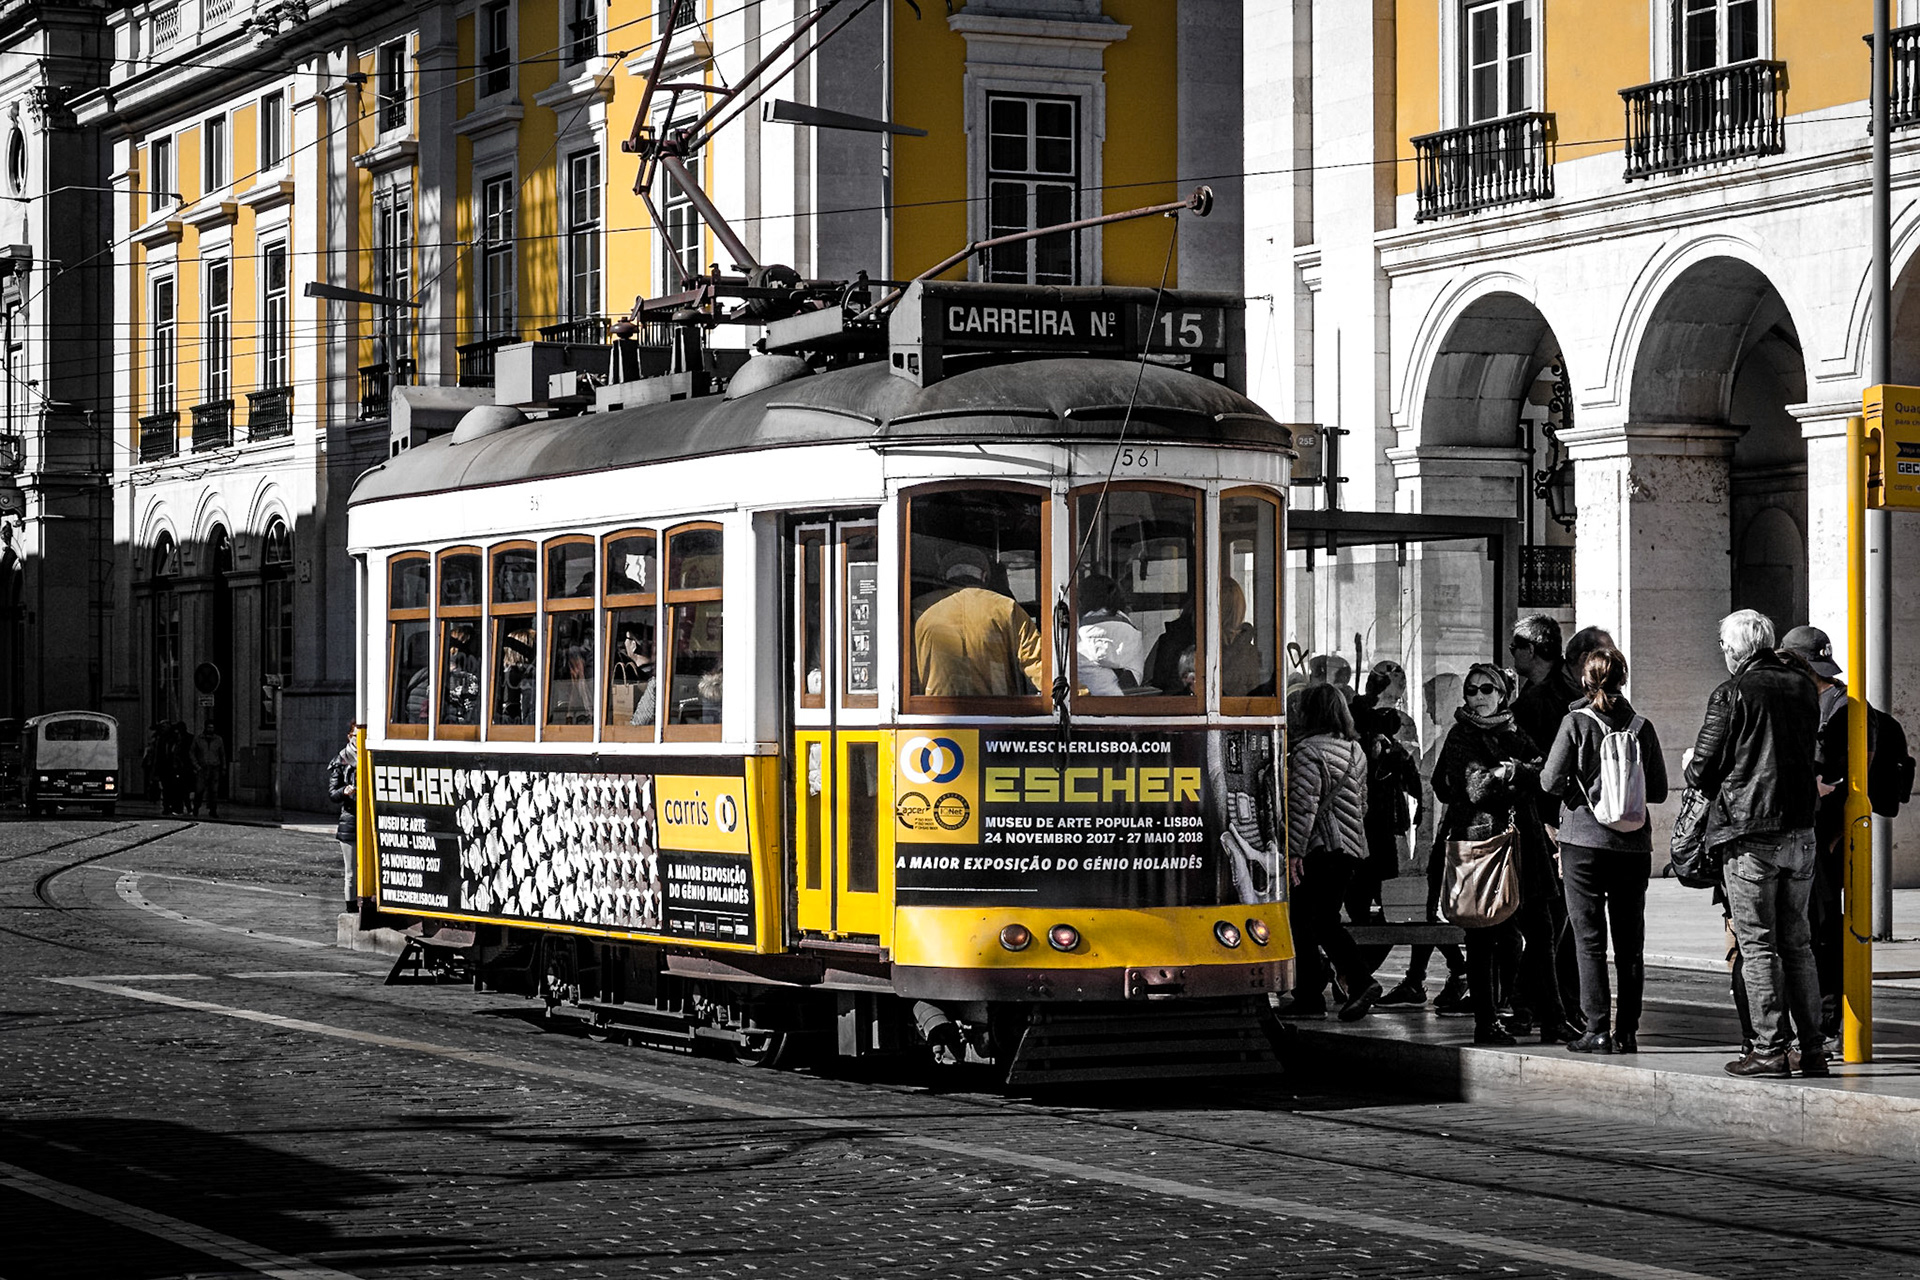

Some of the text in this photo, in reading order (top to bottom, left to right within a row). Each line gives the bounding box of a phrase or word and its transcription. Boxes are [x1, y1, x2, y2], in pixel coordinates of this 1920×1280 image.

[948, 306, 1076, 336] CARREIRA
[1160, 312, 1203, 348] 15
[1122, 449, 1159, 468] 561
[985, 740, 1171, 754] WWW.ESCHERLISBOA.COM
[375, 766, 455, 806] ESCHER
[985, 767, 1201, 803] ESCHER
[664, 790, 709, 826] carris
[378, 815, 427, 833] MUSEU DE ARTE
[985, 816, 1032, 828] MUSEU
[1036, 817, 1054, 828] DE
[1057, 817, 1092, 828] ARTE
[1095, 817, 1153, 828] POPULAR
[1164, 816, 1204, 828] LISBOA
[379, 833, 409, 848] POPULAR
[412, 835, 436, 851] LISBOA
[984, 832, 1002, 844] 24
[1005, 832, 1083, 844] NOVEMBRO
[1086, 832, 1116, 844] 2017
[1126, 832, 1141, 844] 27
[1144, 832, 1175, 844] MAIO
[1178, 832, 1203, 843] 2018
[381, 853, 440, 872] 24 NOVEMBRO 2017
[896, 854, 1203, 873] A MAIOR EXPOSIÇÃO DO GÉNIO HOLANDÊS
[382, 870, 423, 888] 27 MAIO 2018
[667, 864, 747, 887] A MAIOR EXPOSIÇÃO
[669, 881, 749, 905] DO GÉNIO HOLANDÊS
